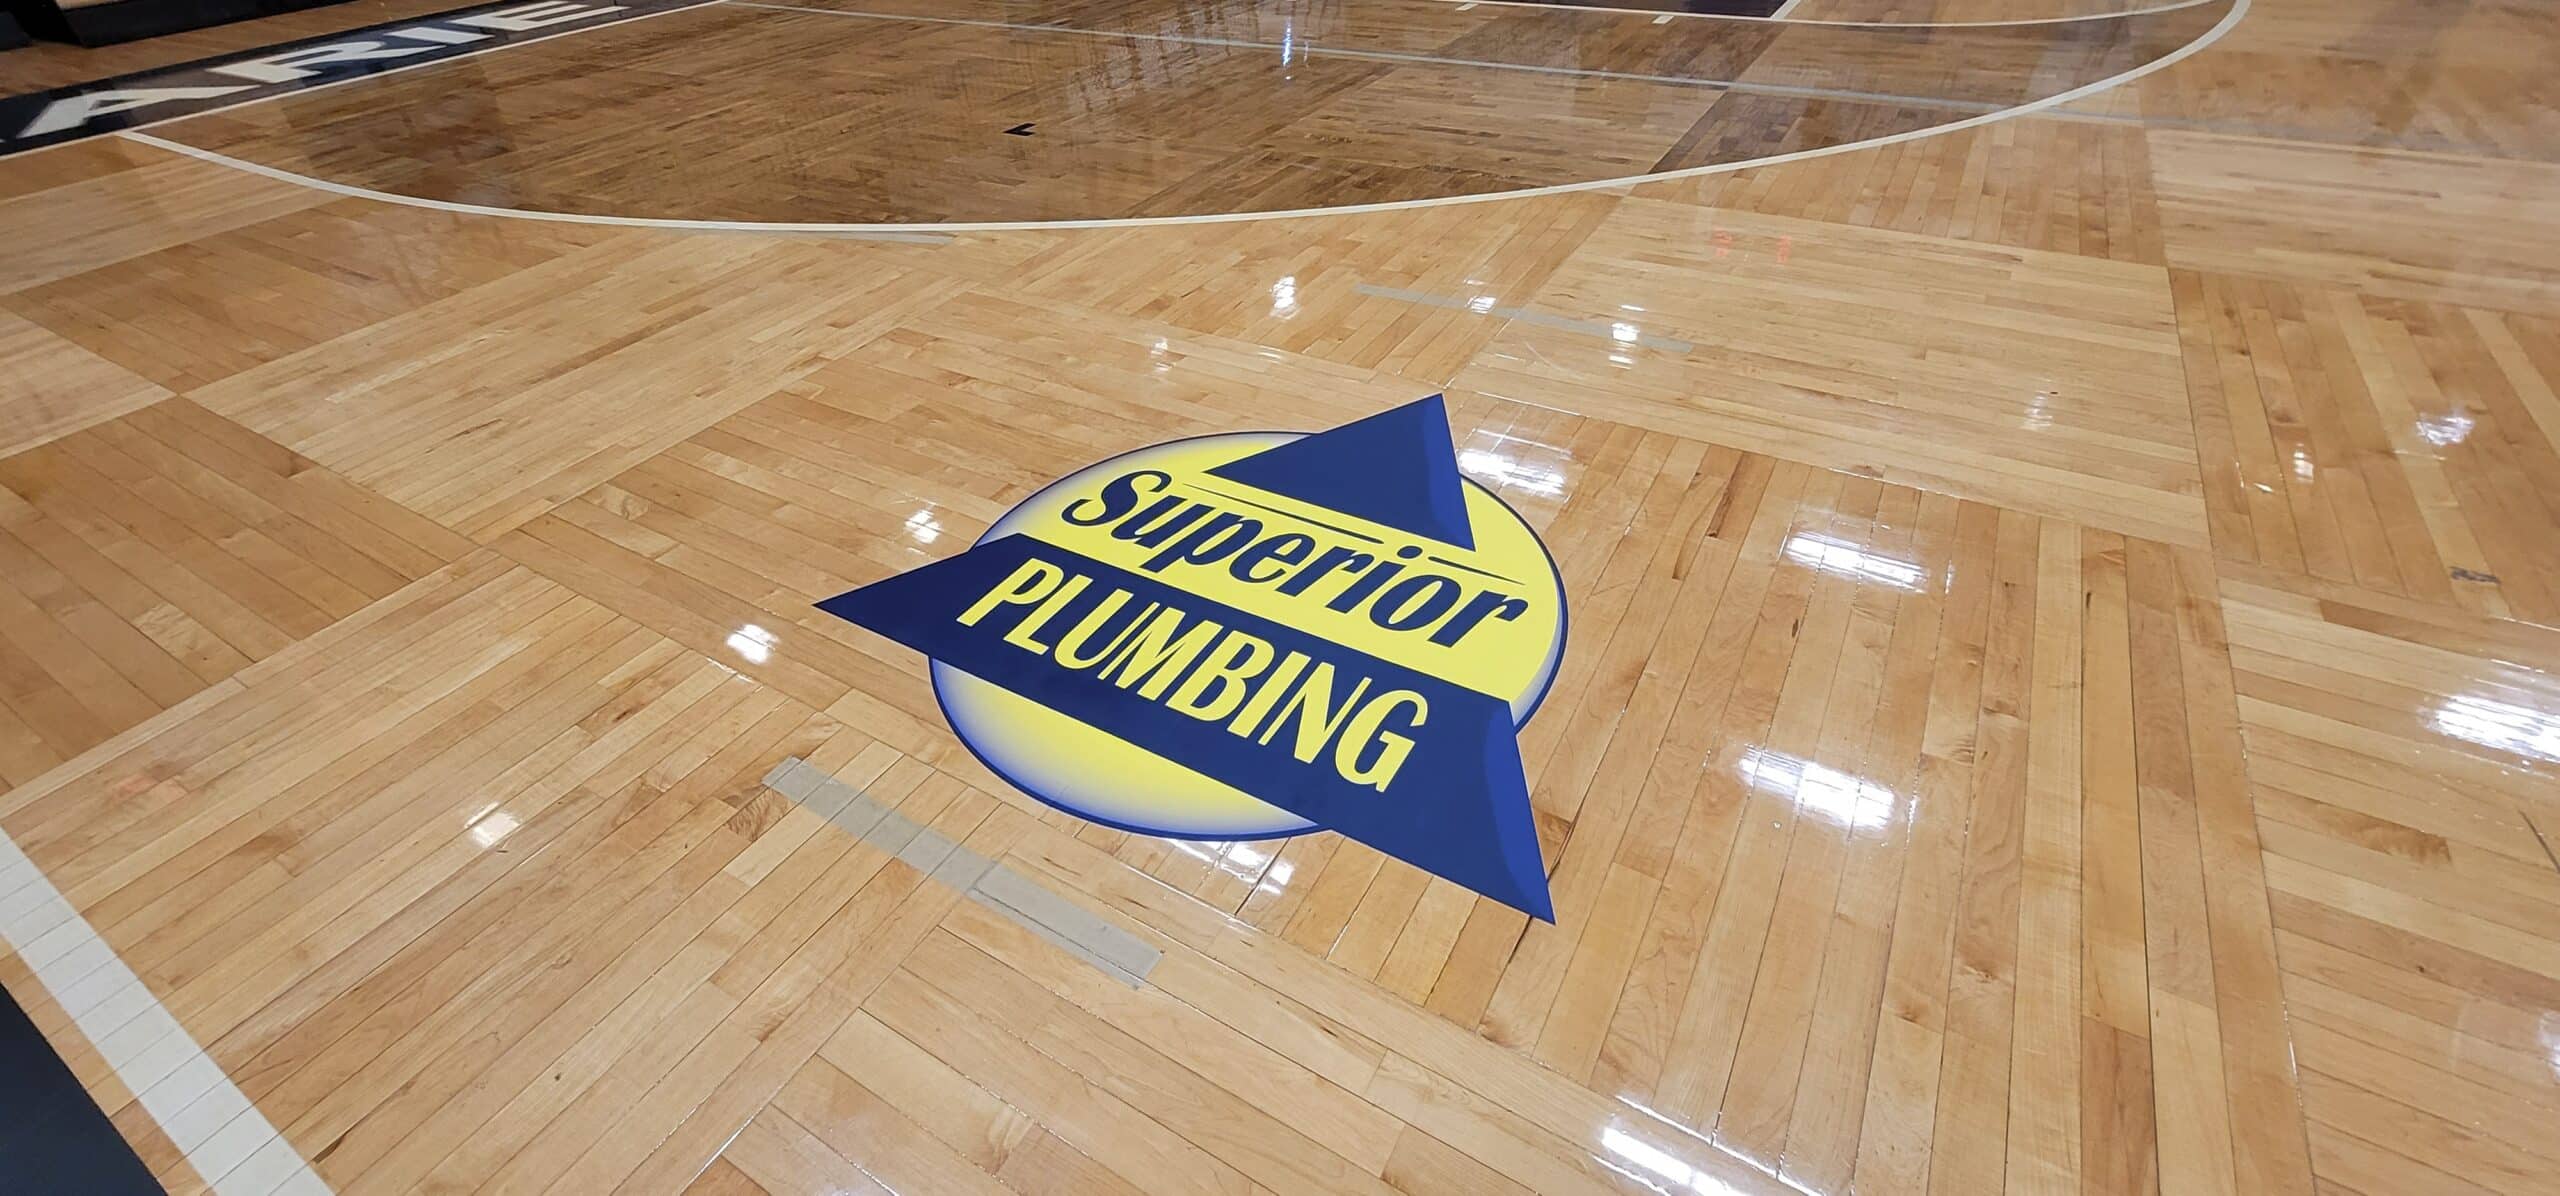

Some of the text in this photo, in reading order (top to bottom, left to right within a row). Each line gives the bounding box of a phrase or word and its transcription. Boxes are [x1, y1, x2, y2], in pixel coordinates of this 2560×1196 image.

[0, 0, 631, 143] ARIE
[1060, 469, 1529, 648] Superior
[955, 557, 1429, 793] PLUMBING
